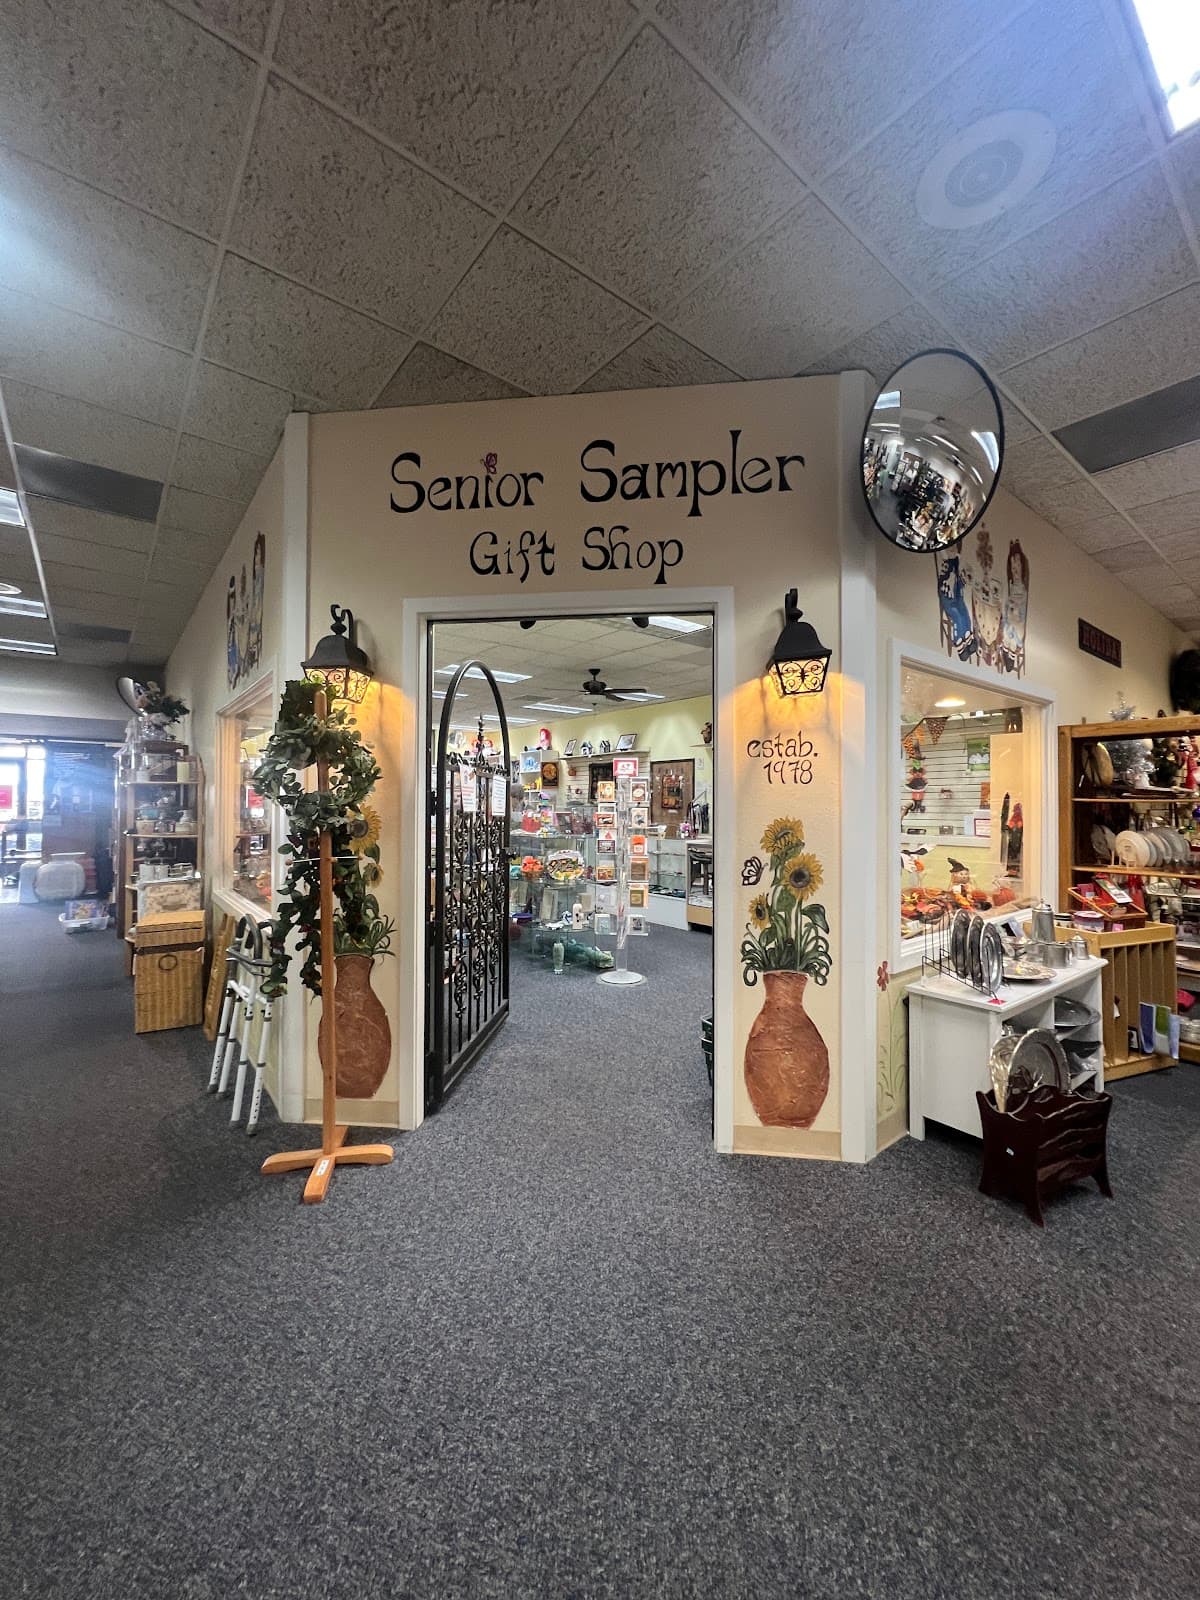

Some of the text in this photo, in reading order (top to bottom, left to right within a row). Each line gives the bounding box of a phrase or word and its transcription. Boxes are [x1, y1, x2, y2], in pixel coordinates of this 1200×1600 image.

[390, 430, 805, 517] Senior Sampler
[469, 525, 684, 585] Gift Shop
[747, 730, 818, 758] estab.
[763, 759, 813, 785] 1978
